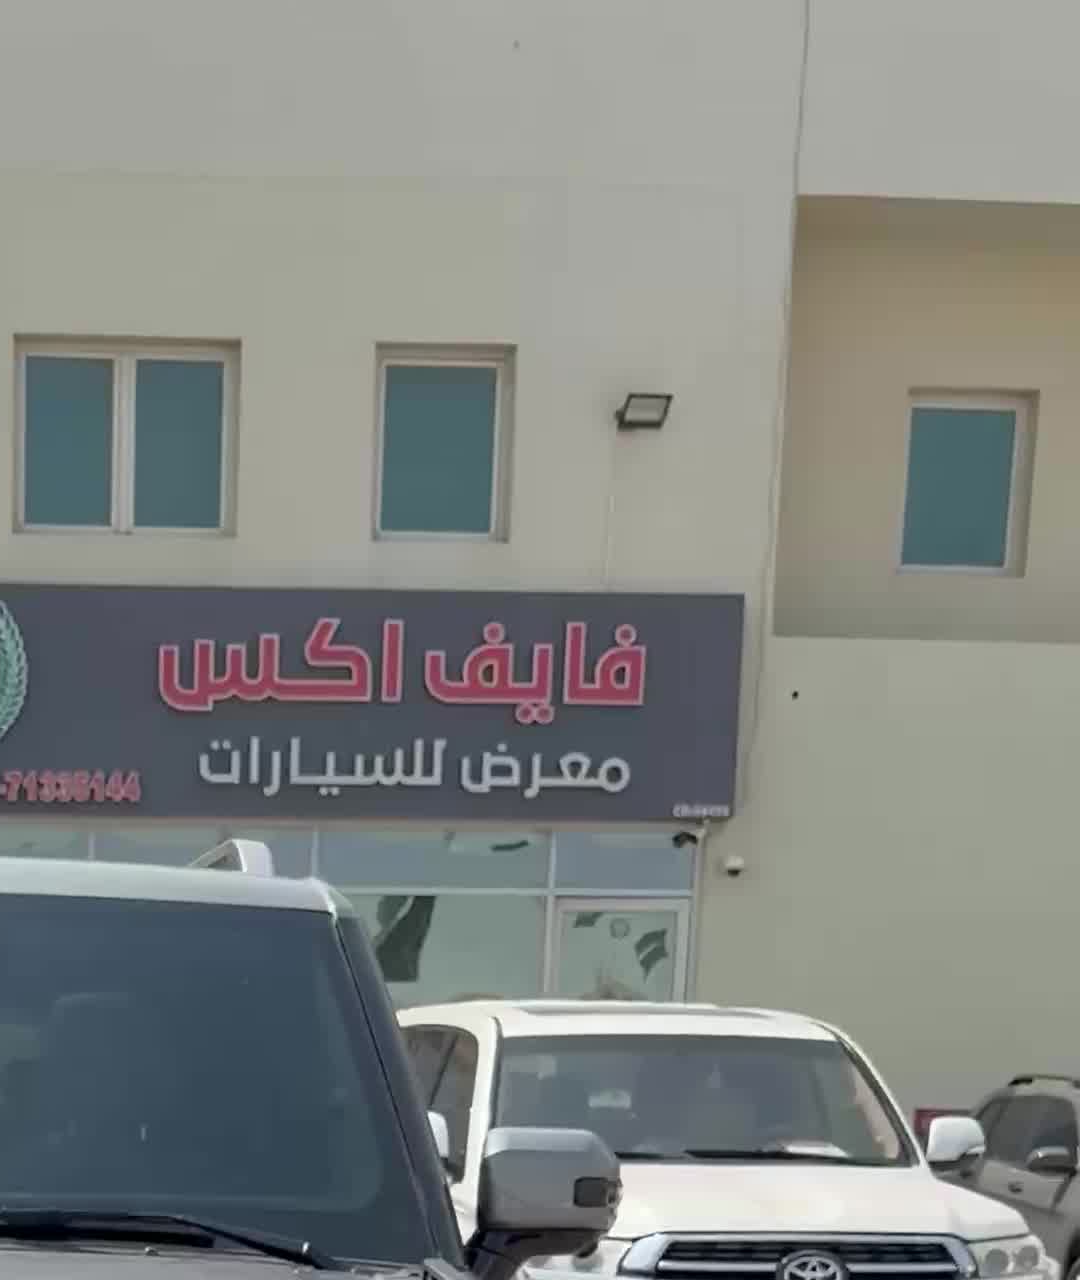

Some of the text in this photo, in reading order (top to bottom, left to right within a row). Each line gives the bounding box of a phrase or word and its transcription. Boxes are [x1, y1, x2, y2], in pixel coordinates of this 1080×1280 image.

[159, 618, 647, 725] فايف اكس
[198, 736, 631, 799] معرض للسيارات
